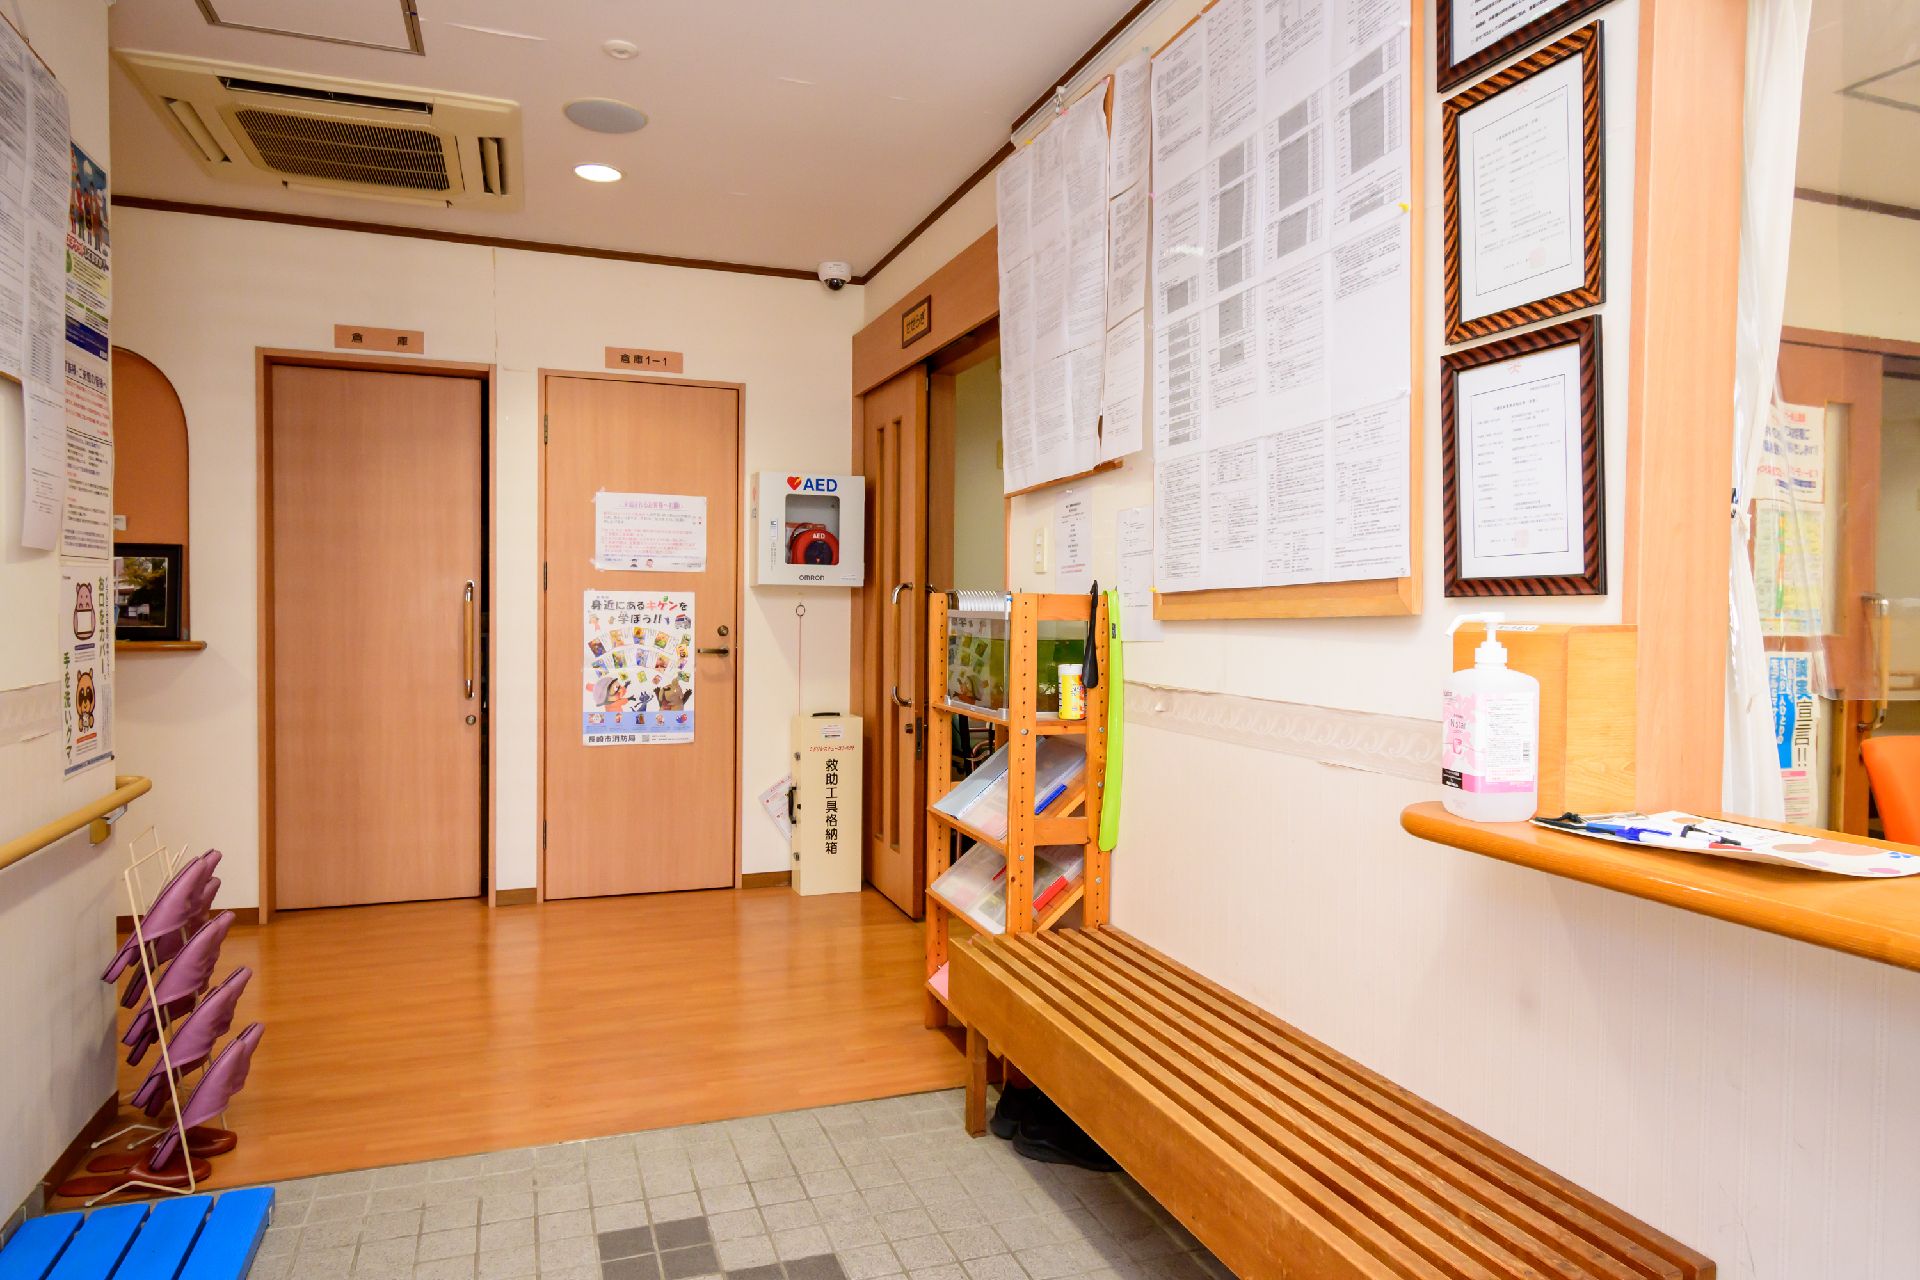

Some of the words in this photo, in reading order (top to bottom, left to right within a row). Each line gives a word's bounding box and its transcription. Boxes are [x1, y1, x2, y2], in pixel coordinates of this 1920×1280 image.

[803, 477, 838, 492] AED
[825, 758, 839, 855] 救助工具格納箱
